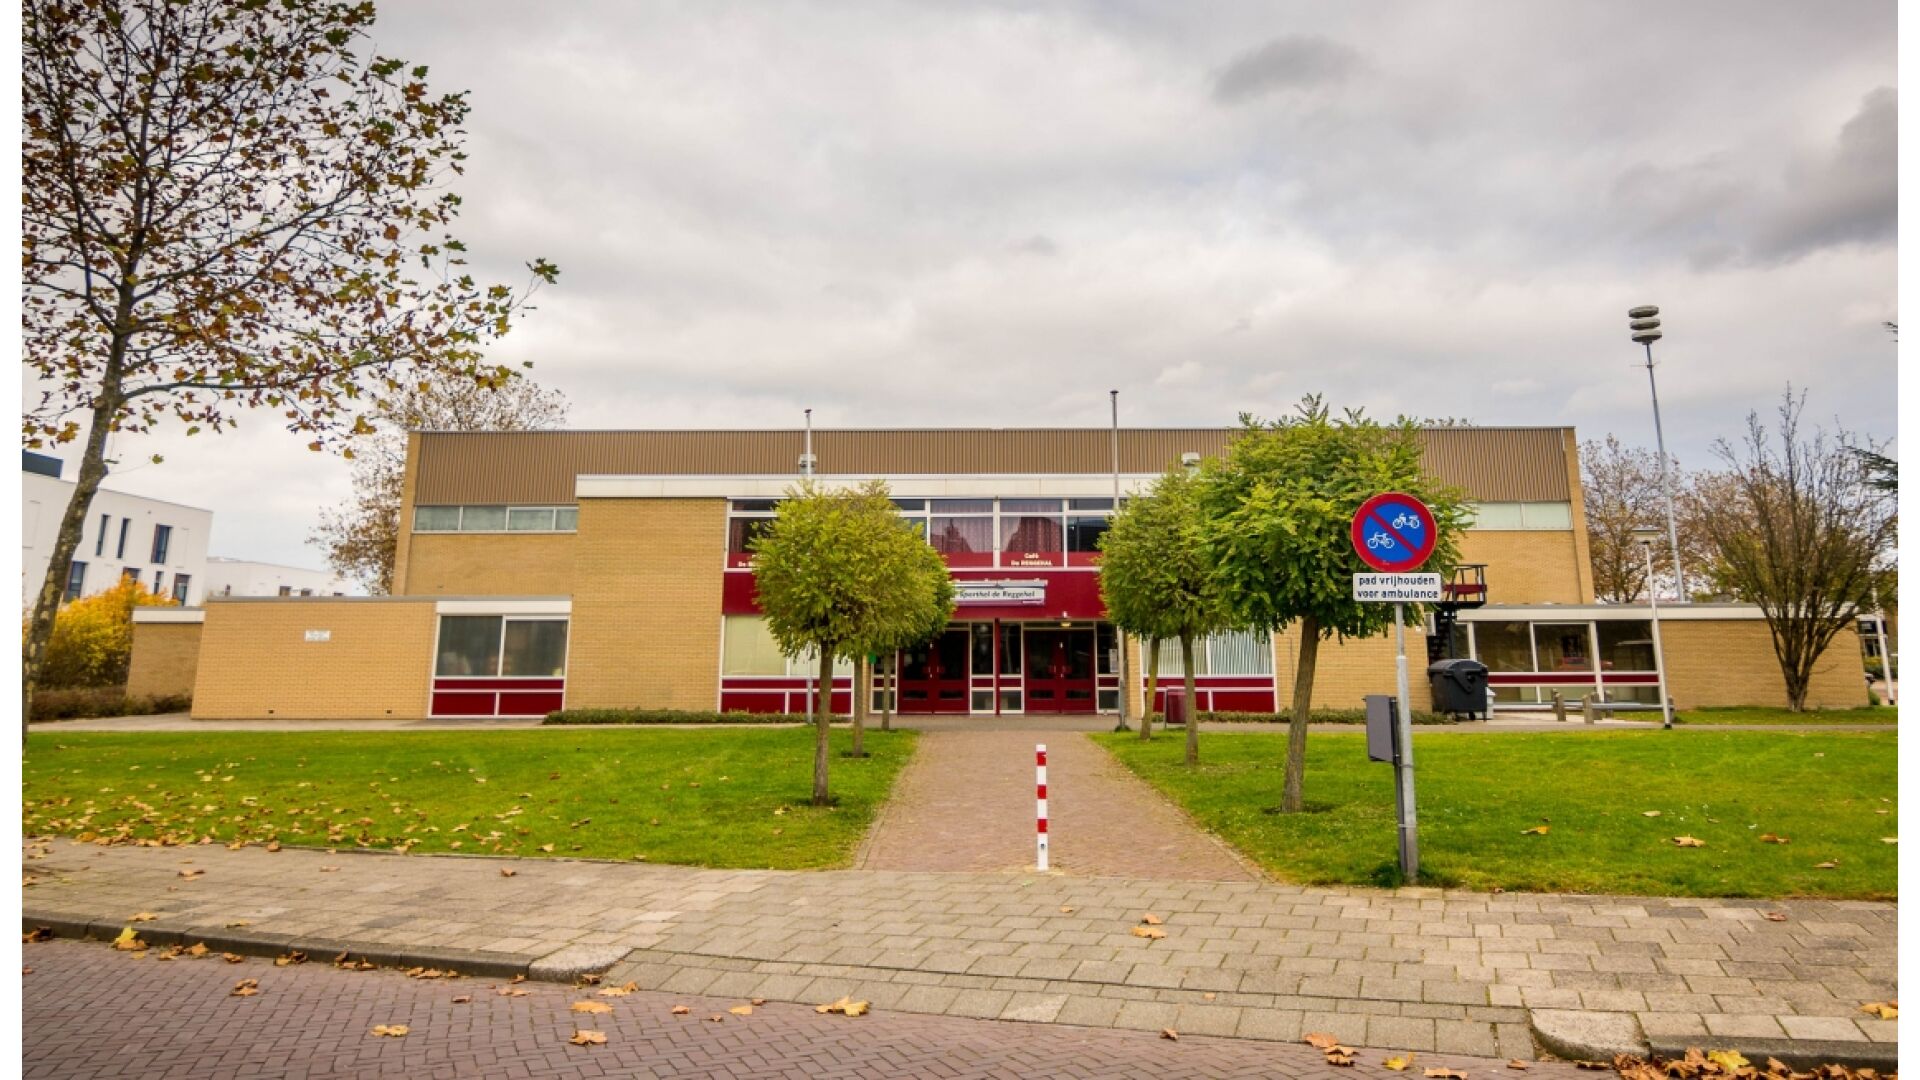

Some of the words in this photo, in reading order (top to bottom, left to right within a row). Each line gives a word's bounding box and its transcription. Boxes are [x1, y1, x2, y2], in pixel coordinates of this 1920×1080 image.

[1359, 576, 1377, 586] pad
[1379, 576, 1435, 587] vrijhouden
[992, 590, 1000, 598] de
[1357, 590, 1379, 598] voor
[1381, 589, 1438, 598] ambulance
